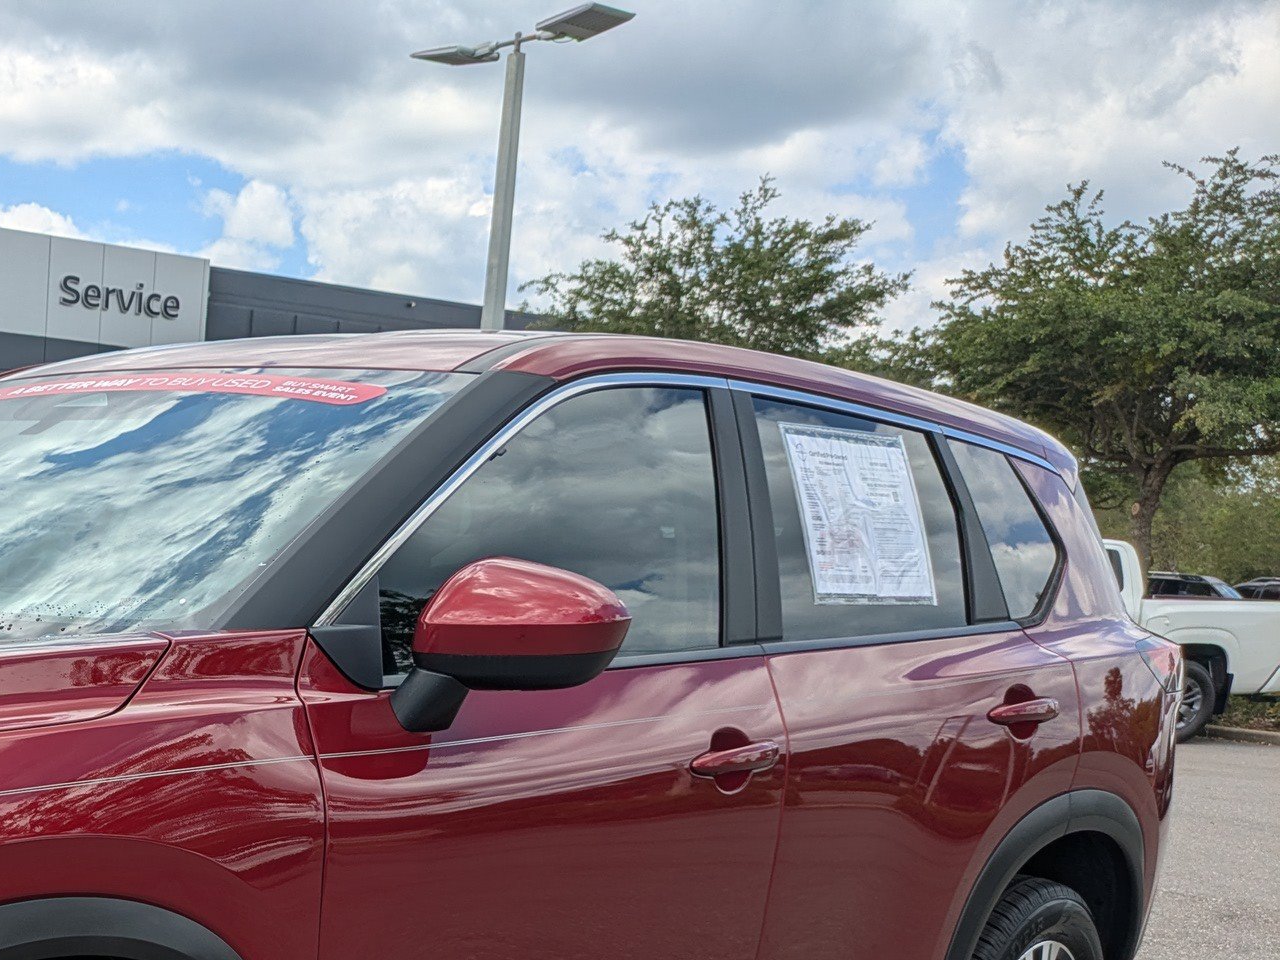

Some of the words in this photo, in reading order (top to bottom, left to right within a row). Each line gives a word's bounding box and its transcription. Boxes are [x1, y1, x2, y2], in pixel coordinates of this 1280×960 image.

[59, 274, 180, 320] Service
[23, 381, 95, 394] BETTER
[93, 377, 140, 388] WAY
[143, 377, 169, 386] TO
[172, 376, 215, 387] BUY
[211, 378, 272, 389] USED
[272, 385, 312, 396] SALES
[314, 389, 358, 402] EVENT
[282, 380, 312, 389] BUY
[308, 382, 357, 393] SMART
